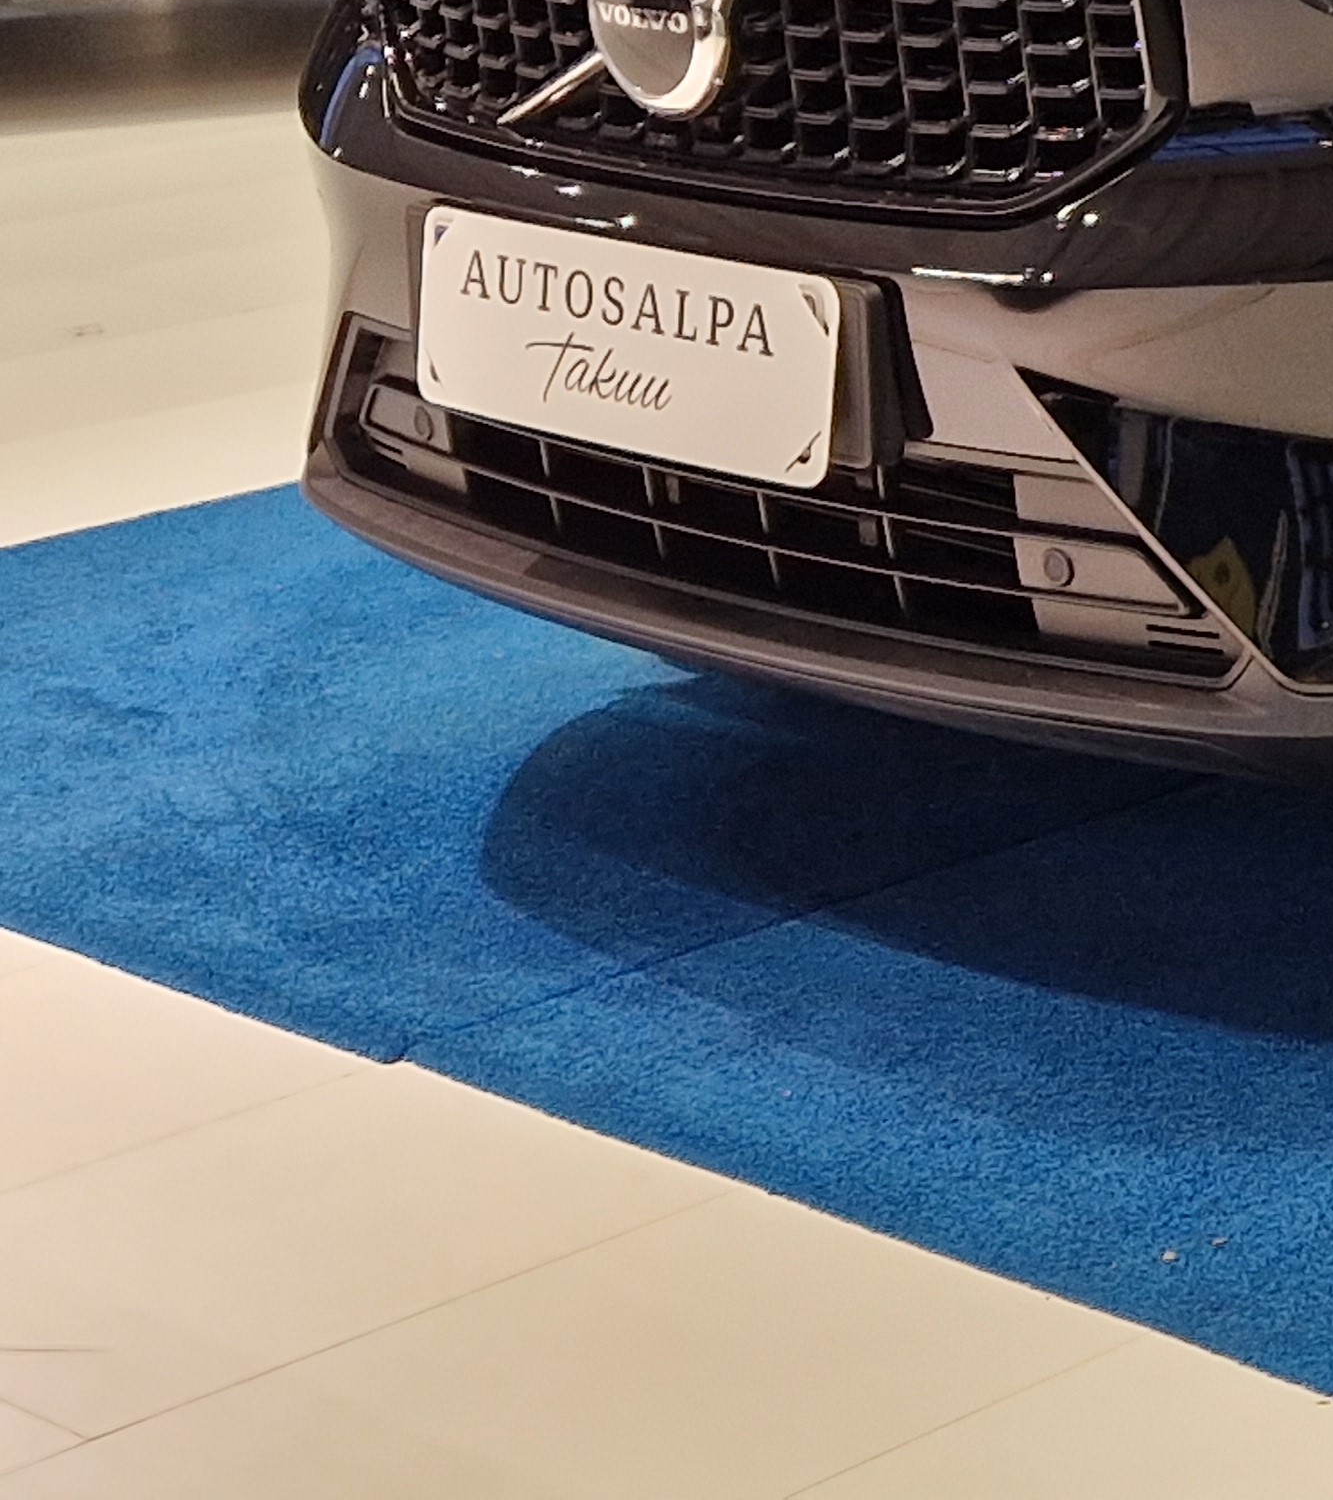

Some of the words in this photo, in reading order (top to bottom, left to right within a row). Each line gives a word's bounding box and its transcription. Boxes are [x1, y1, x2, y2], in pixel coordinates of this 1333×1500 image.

[596, 1, 689, 34] VOLVO
[460, 249, 775, 357] AUTOSALPA
[525, 331, 673, 411] Takuu
